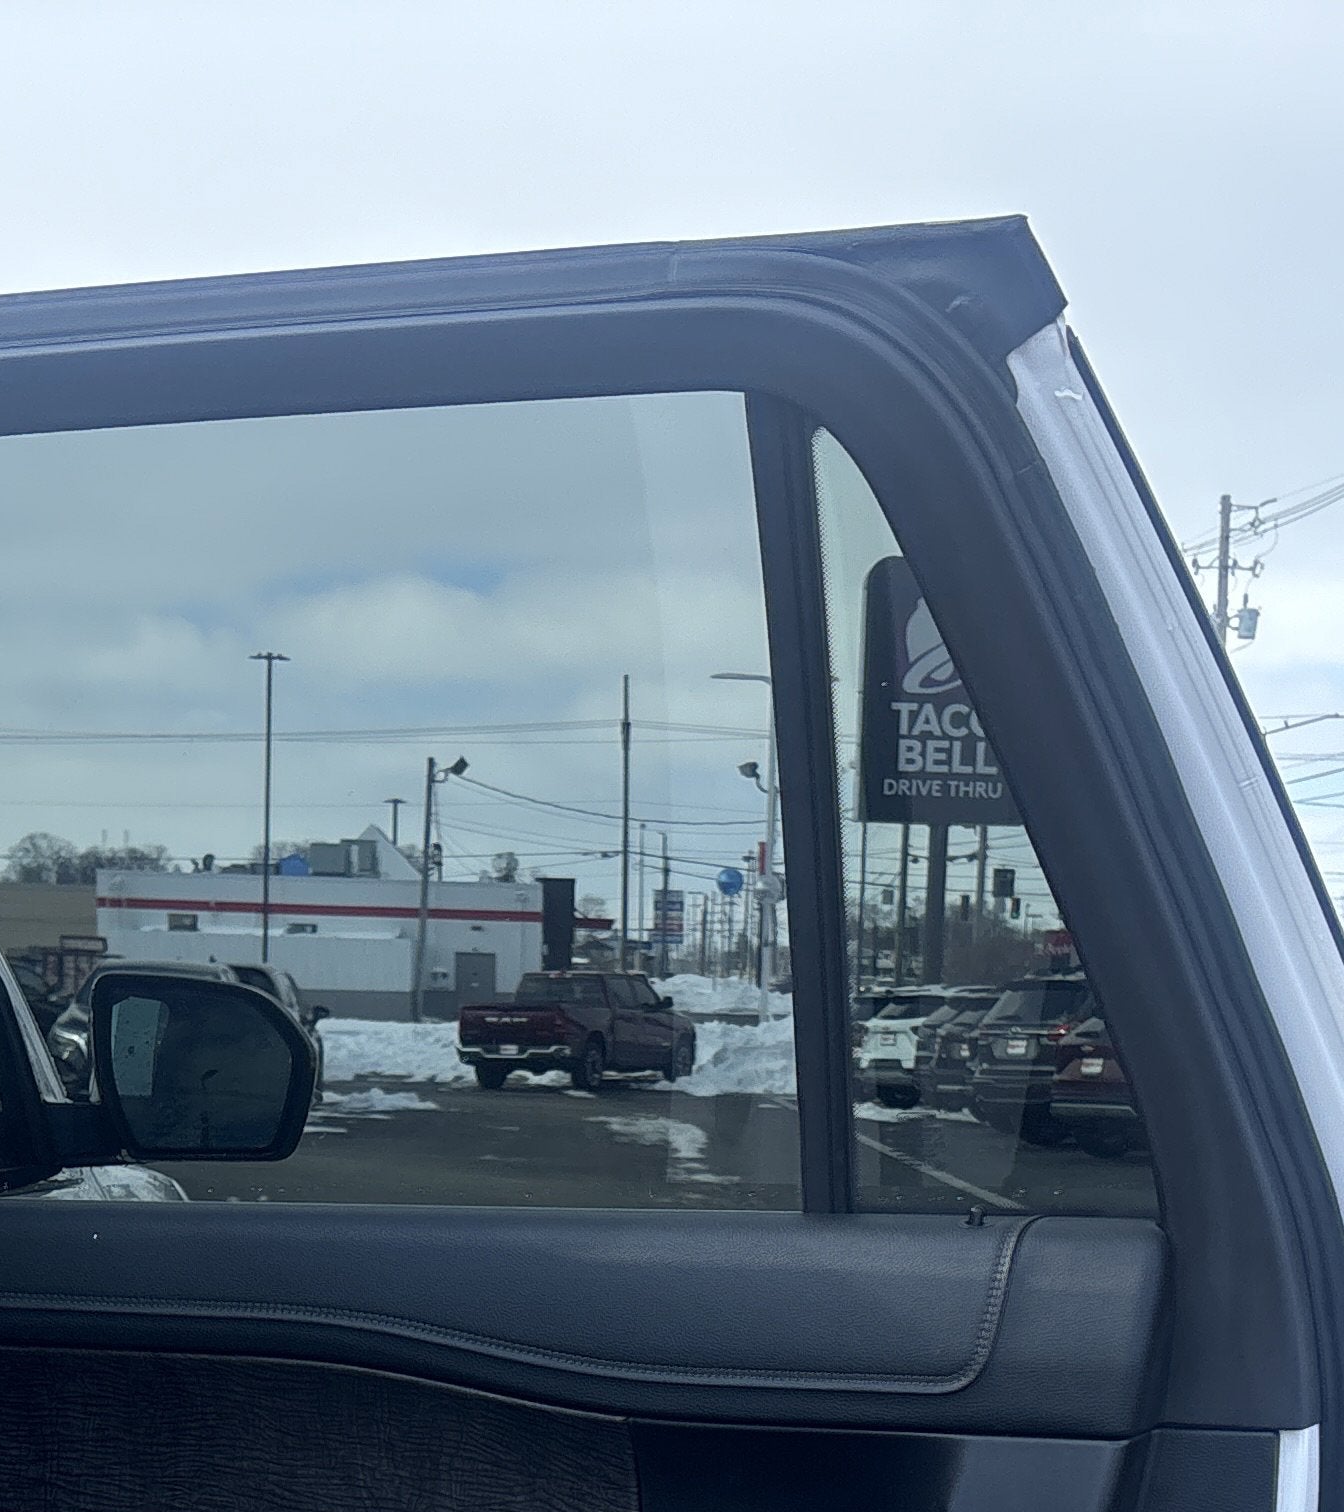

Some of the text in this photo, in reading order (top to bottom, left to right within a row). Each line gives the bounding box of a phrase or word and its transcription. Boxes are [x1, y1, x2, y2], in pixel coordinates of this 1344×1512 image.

[897, 739, 998, 775] BELL
[882, 778, 1003, 799] DRIVE THRU
